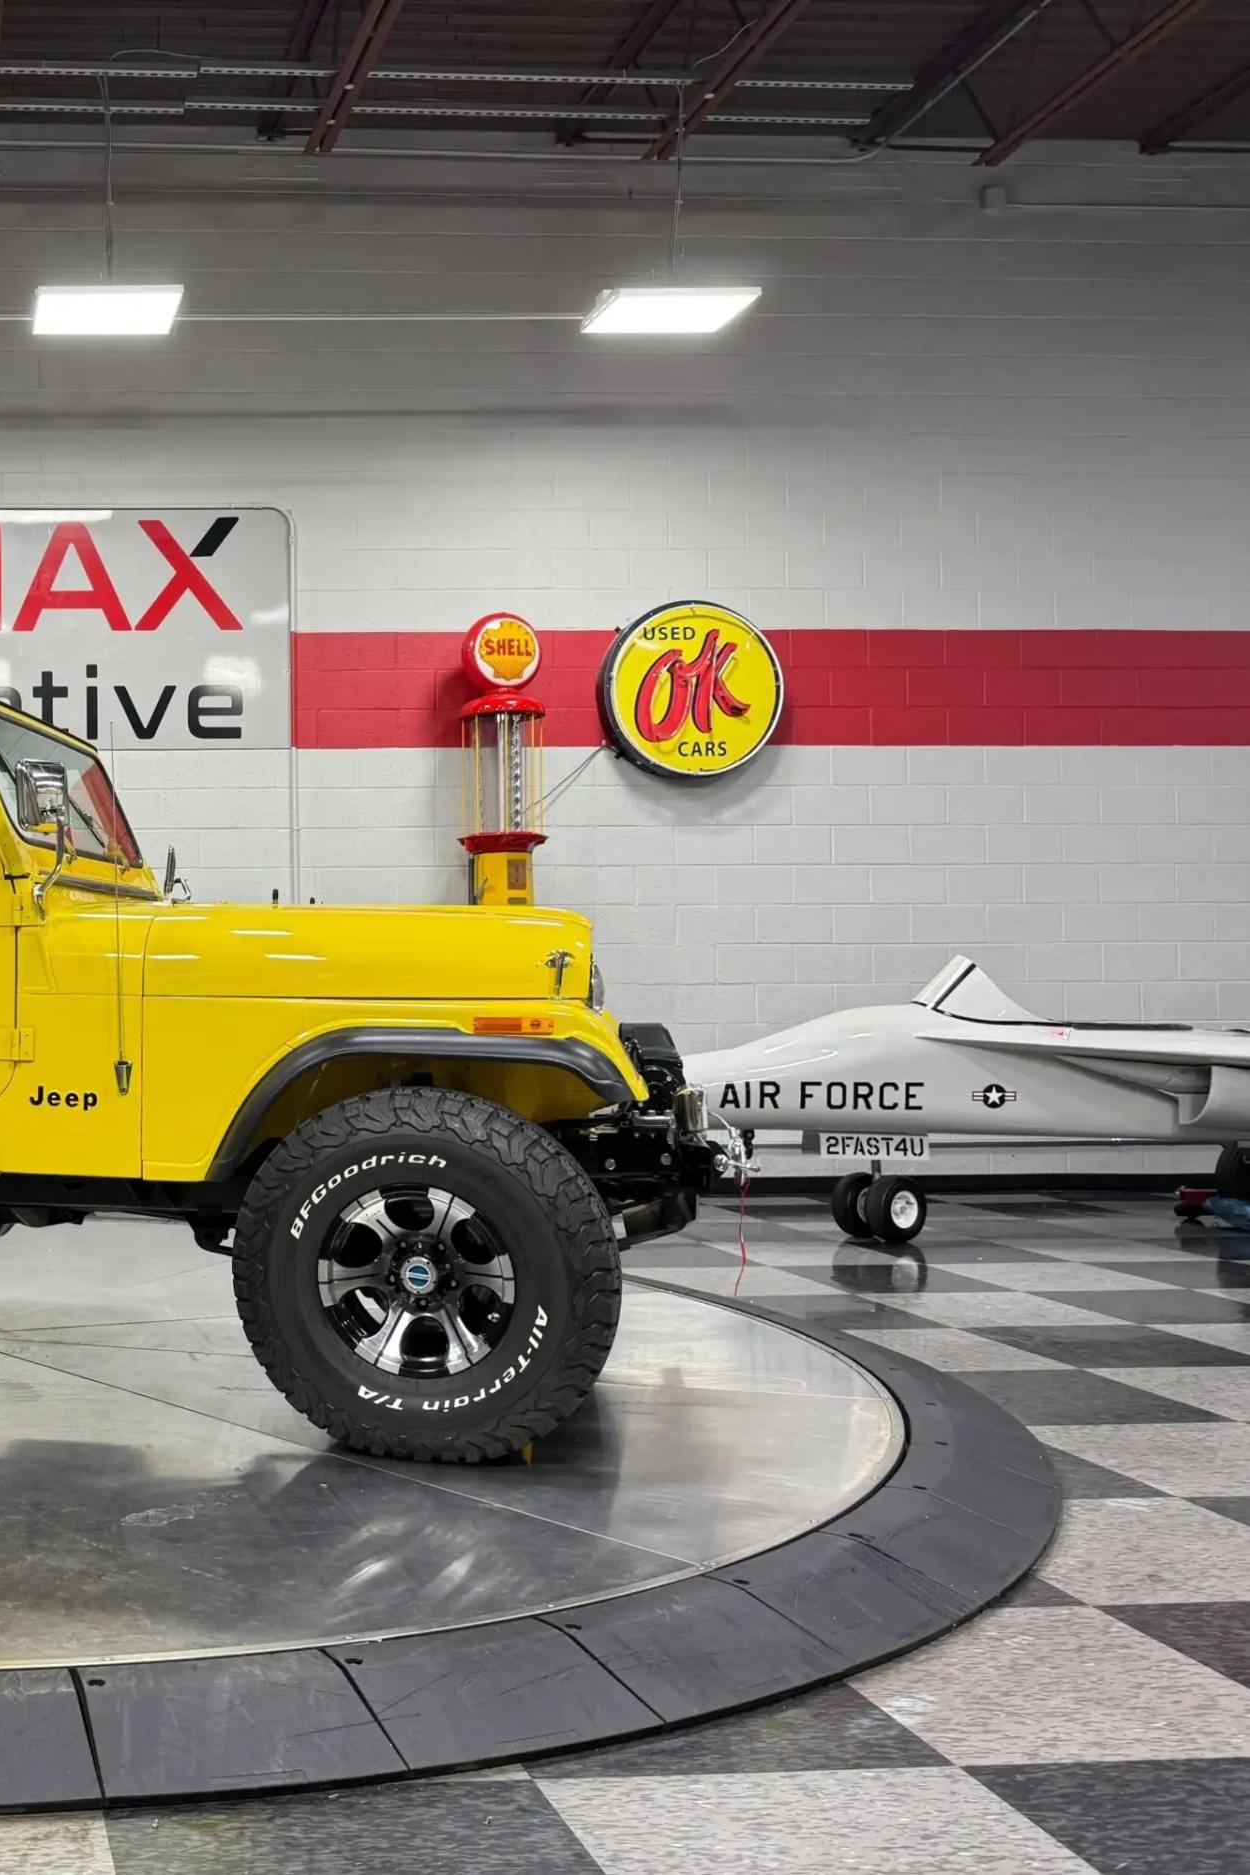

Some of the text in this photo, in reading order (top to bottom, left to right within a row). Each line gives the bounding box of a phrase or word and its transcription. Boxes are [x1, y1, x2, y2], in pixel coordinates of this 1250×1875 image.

[643, 627, 696, 641] USED
[484, 638, 533, 657] SHELL
[634, 629, 751, 743] OK
[677, 741, 727, 757] CARS
[29, 1085, 98, 1111] Jeep
[719, 1081, 924, 1110] AIR FORCE
[825, 1136, 924, 1158] 2FAST4U
[290, 1151, 448, 1240] BFGoodrich
[357, 1304, 549, 1412] All-Terrain T/A
